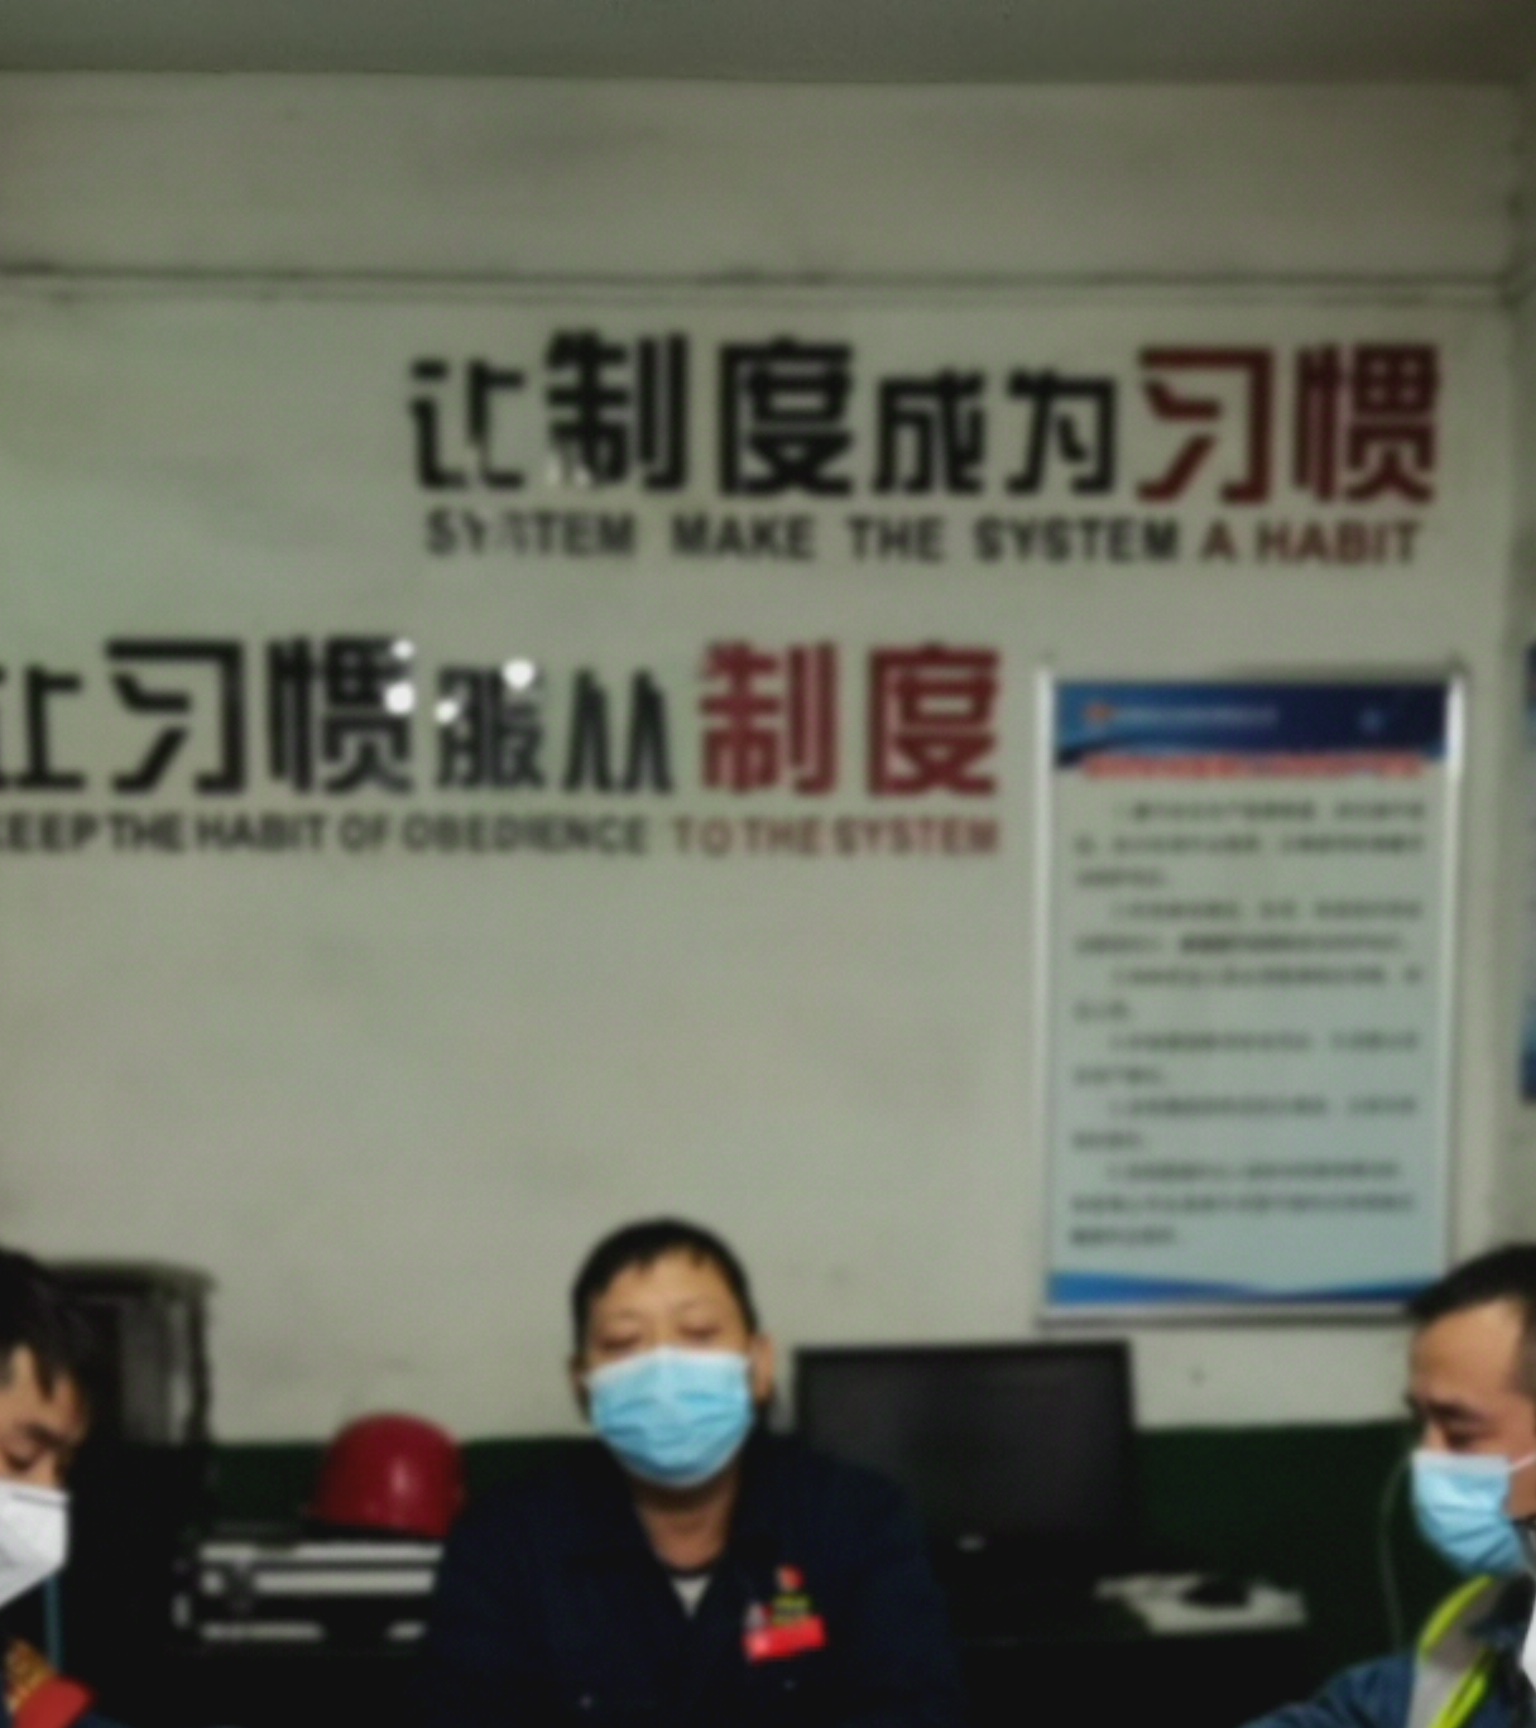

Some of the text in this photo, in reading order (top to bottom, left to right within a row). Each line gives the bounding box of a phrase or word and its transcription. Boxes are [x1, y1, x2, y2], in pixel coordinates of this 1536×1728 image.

[410, 329, 1438, 504] 让制度成为习惯
[671, 511, 812, 560] MAKE
[848, 514, 943, 562] THE
[974, 517, 1177, 564] SYSTEM
[1200, 520, 1239, 564] A
[1257, 519, 1421, 566] HABIT
[107, 812, 186, 852] THE
[195, 812, 326, 853] HABIT
[338, 812, 395, 853] OF
[400, 813, 648, 854] OBEDIENCE
[671, 815, 736, 855] TO
[743, 815, 820, 855] THE
[830, 815, 1000, 855] SYSTEM
